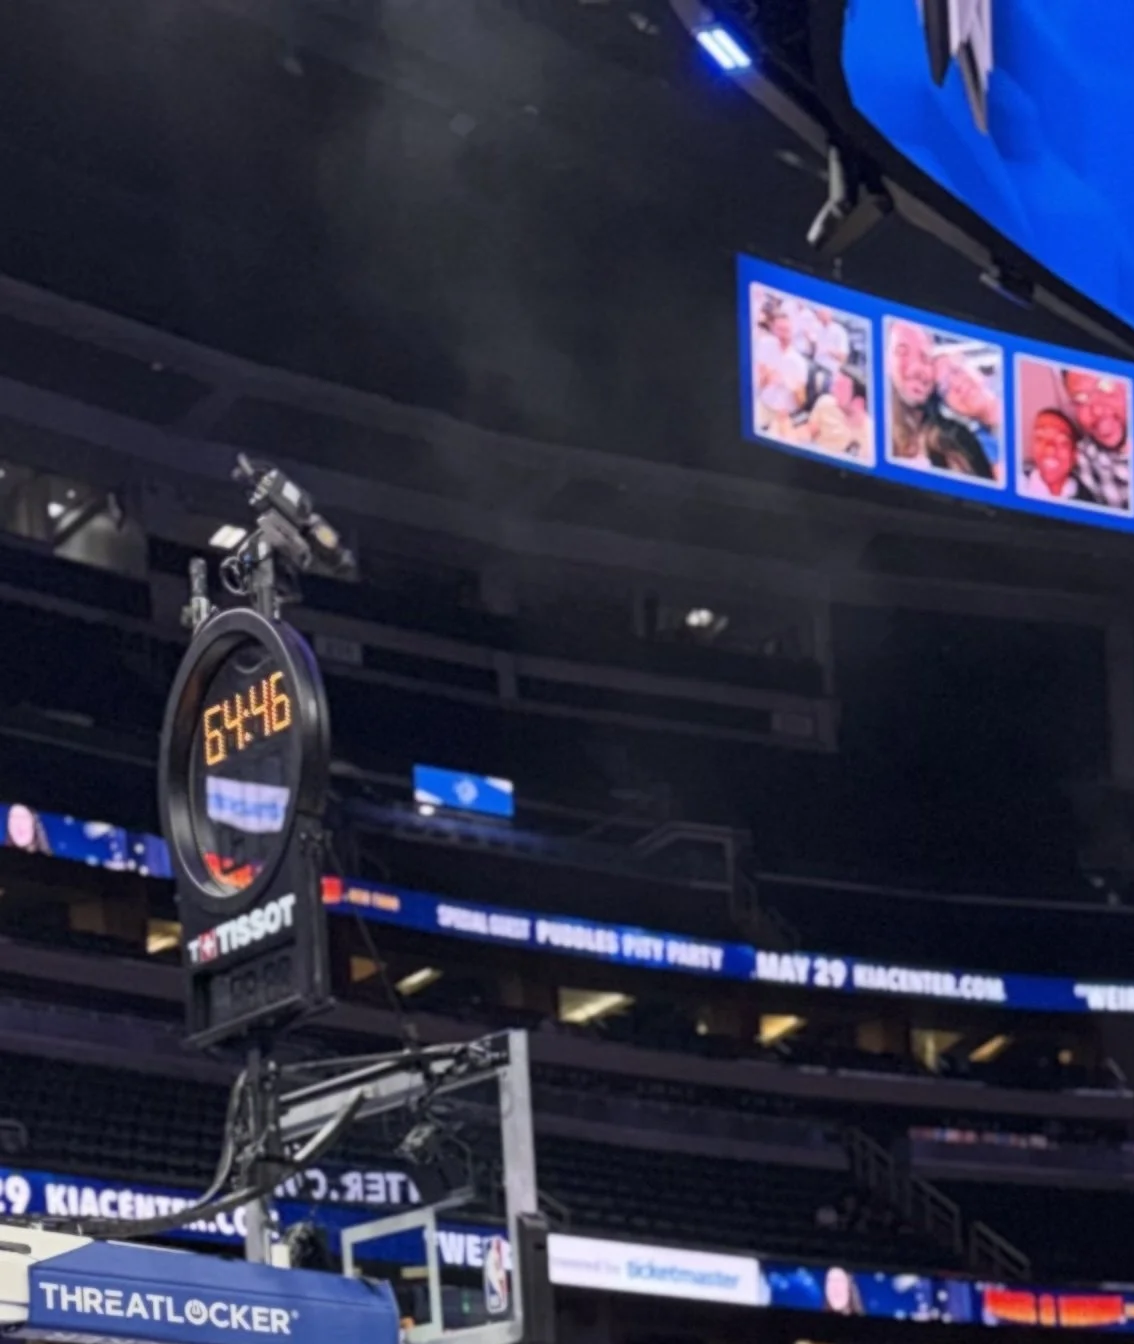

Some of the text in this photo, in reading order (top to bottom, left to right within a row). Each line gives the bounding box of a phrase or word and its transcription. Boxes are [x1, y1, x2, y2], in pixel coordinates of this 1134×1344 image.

[203, 671, 291, 766] 64:46
[622, 933, 664, 962] PITY
[666, 940, 723, 971] PARTY
[756, 951, 810, 985] MAY
[814, 957, 847, 988] 29
[853, 964, 1006, 1002] KIACENTER.COM
[0, 1175, 31, 1215] 9
[627, 1259, 741, 1289] ticketmaster
